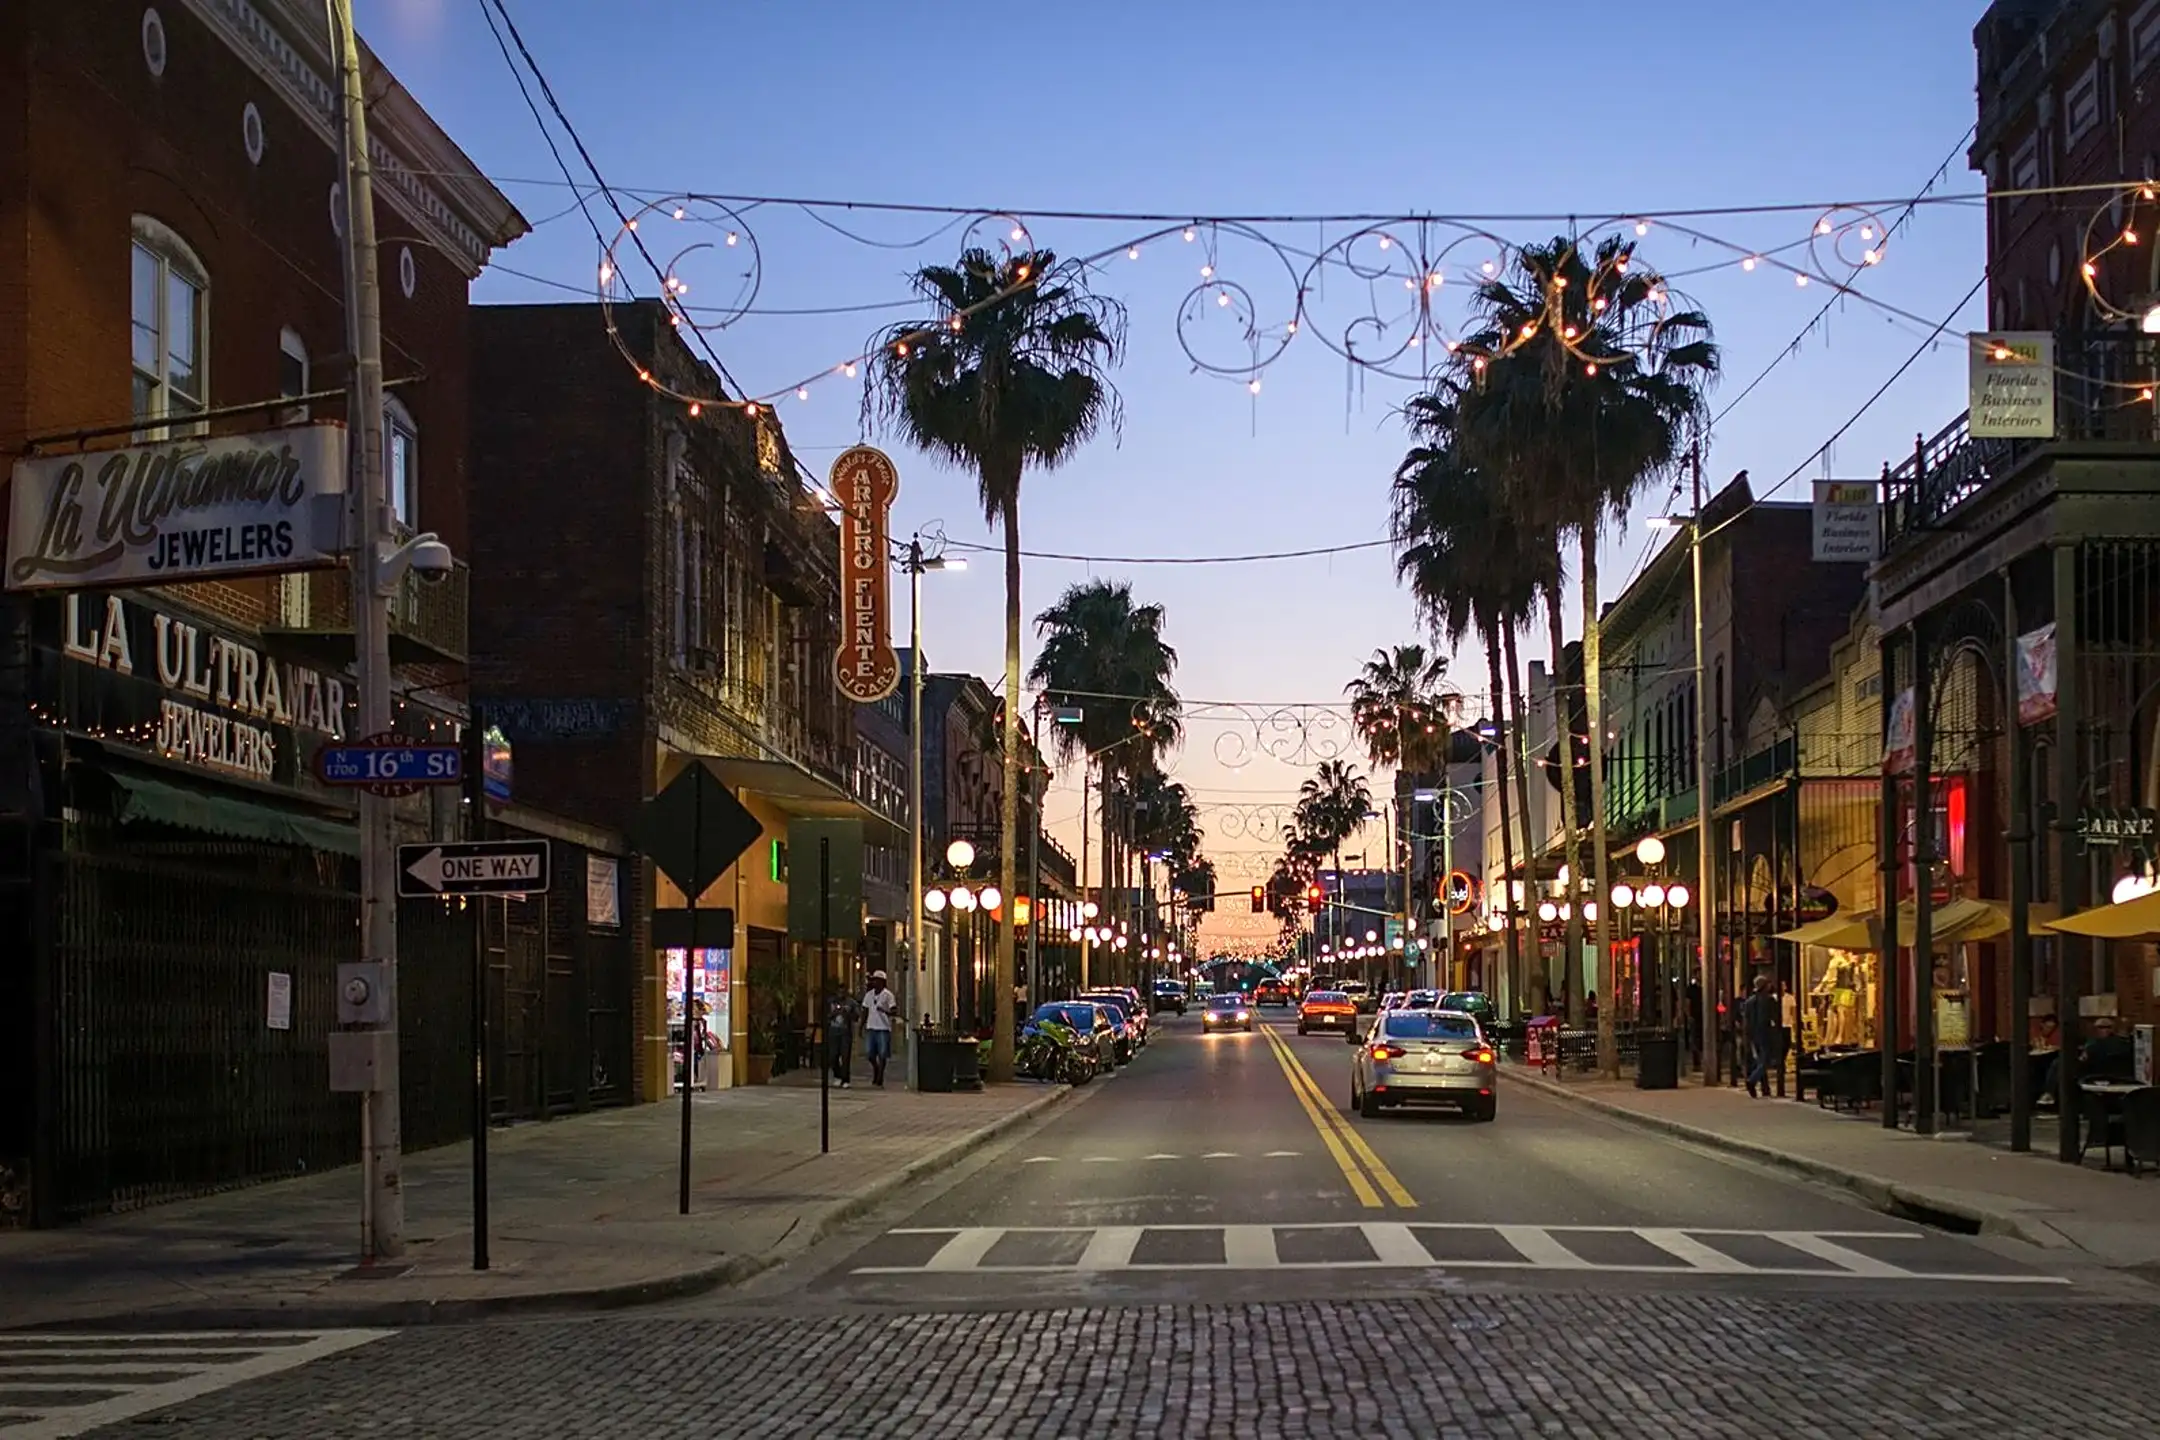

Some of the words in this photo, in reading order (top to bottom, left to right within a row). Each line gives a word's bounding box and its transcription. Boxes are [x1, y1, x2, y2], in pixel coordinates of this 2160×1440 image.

[1986, 373, 2039, 386] Florida
[1981, 394, 2043, 406] Business
[1981, 414, 2043, 427] Interiors
[12, 462, 102, 581] La
[98, 445, 304, 545] Ultramar
[852, 469, 875, 570] ARTURO
[148, 520, 293, 570] JEWELERS
[855, 578, 875, 677] FUENTE
[64, 593, 133, 676] LA
[154, 613, 346, 742] ULTRAMAR
[839, 667, 895, 696] CIGARS
[156, 700, 274, 776] JEWELERS
[369, 734, 415, 747] YBOR
[336, 752, 347, 763] N
[365, 751, 414, 778] 16th
[427, 753, 456, 776] St
[326, 764, 359, 776] 1700
[371, 783, 413, 795] CITY
[442, 858, 484, 879] ONE
[490, 857, 534, 877] WAY
